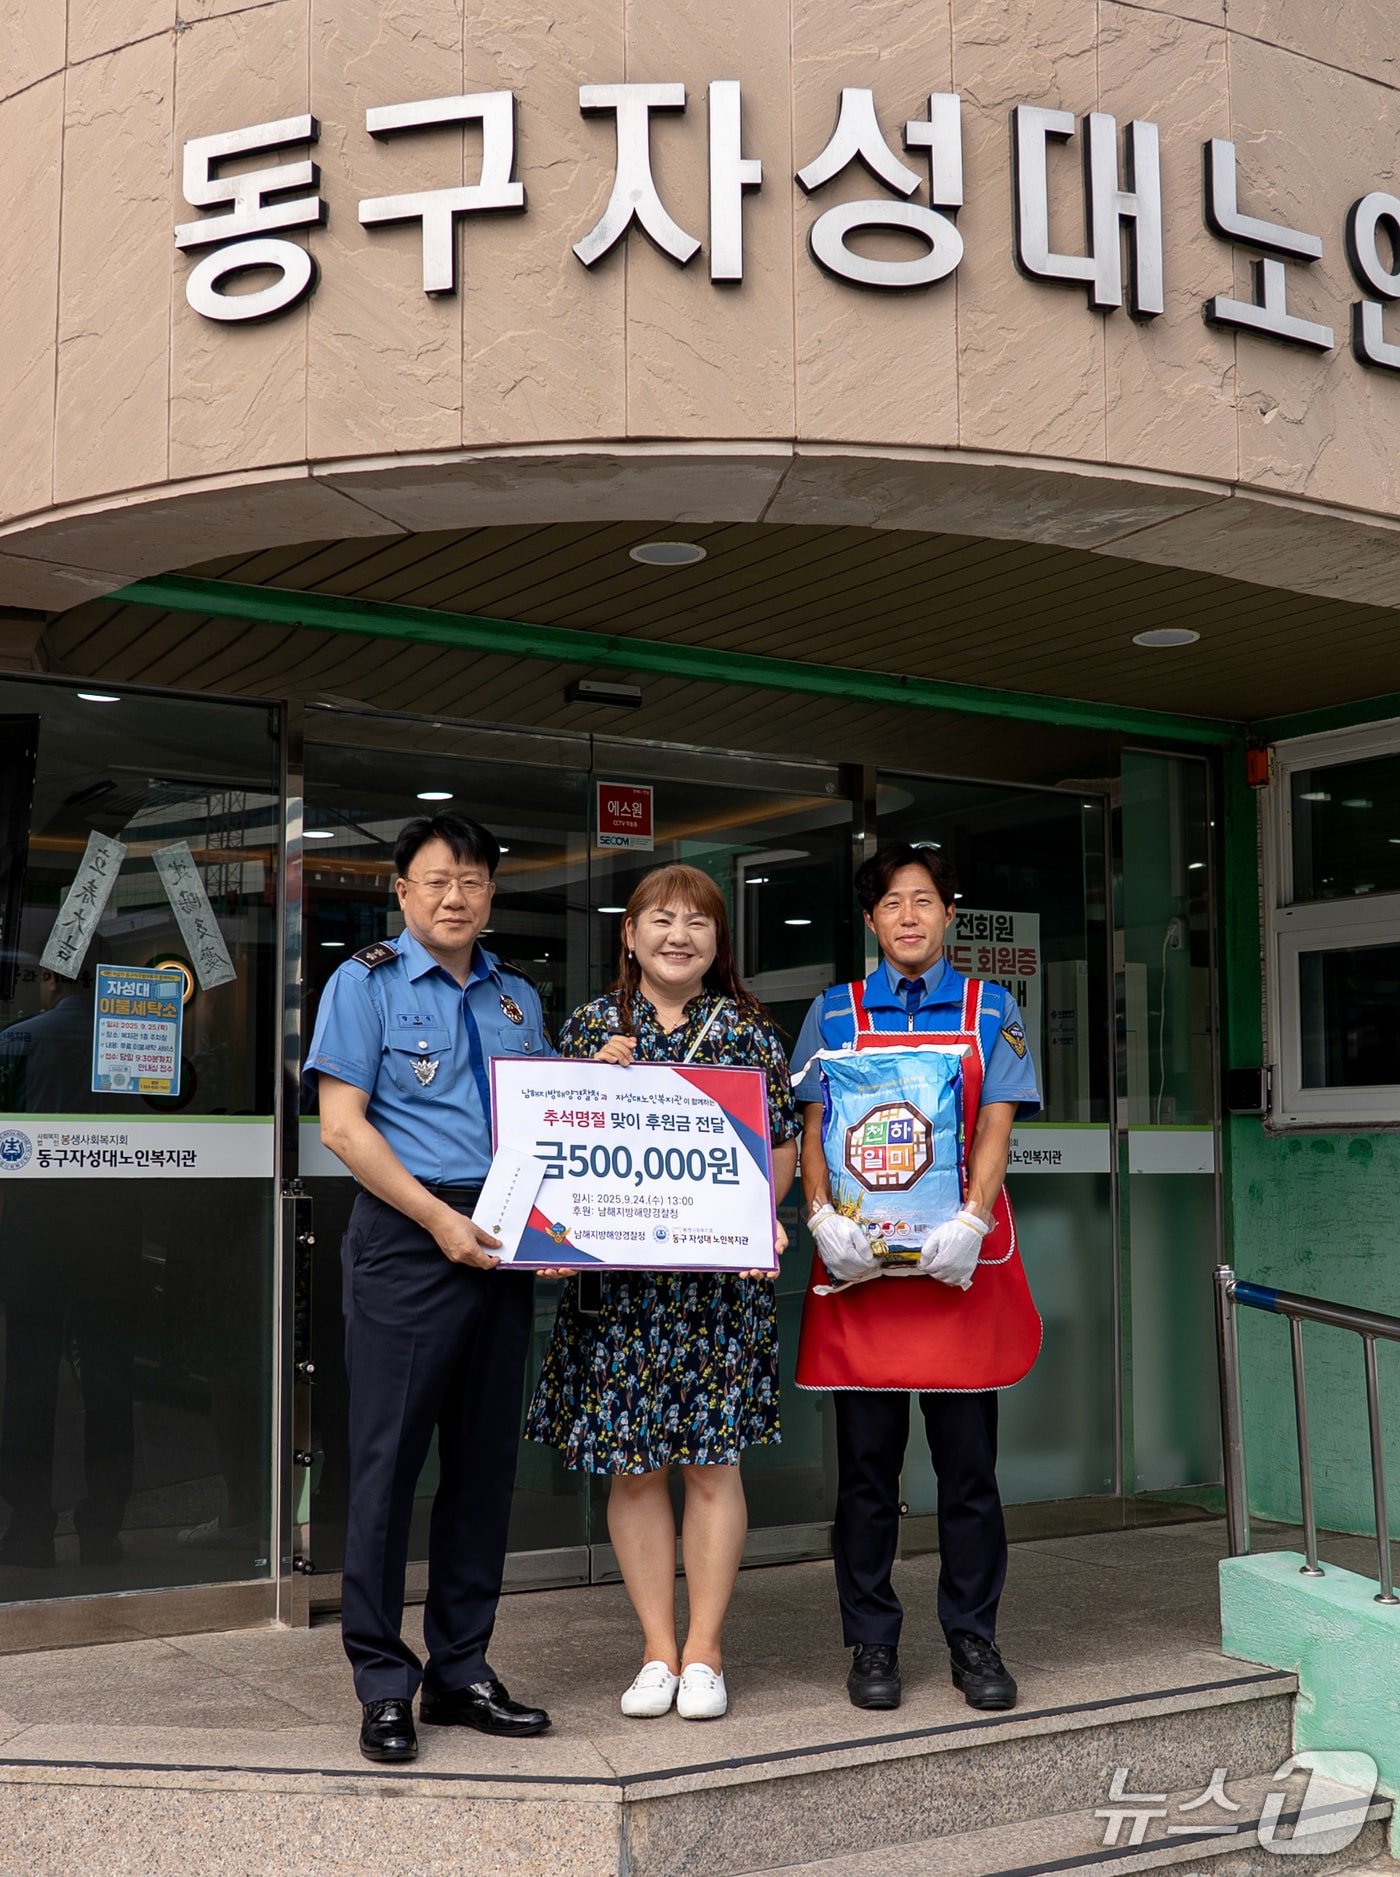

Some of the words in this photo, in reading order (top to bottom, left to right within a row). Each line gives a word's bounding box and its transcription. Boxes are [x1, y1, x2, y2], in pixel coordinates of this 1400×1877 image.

[607, 800, 643, 818] 에스원
[600, 835, 629, 846] SECOM
[977, 946, 1037, 976] 회원증
[107, 980, 150, 998] 자성대
[99, 998, 177, 1019] 이불세탁소
[691, 1097, 716, 1107] 함께하는
[543, 1109, 606, 1128] 추석명절
[610, 1112, 640, 1130] 맞이
[645, 1113, 691, 1132] 후원금
[695, 1116, 725, 1134] 전달
[60, 1133, 128, 1146] 봉생사회복지회
[36, 1149, 198, 1169] 동구자성대노인복지관
[532, 1140, 740, 1187] 금500,000원
[572, 1193, 594, 1204] 일시:
[597, 1193, 664, 1207] 2025.9.24.(수)
[667, 1196, 694, 1206] 13:00
[572, 1206, 594, 1217] 후원:
[597, 1207, 679, 1219] 남해지방해양경찰청
[574, 1229, 646, 1241] 남해지방해양경찰청
[672, 1233, 687, 1244] 동구
[689, 1234, 711, 1245] 자성대
[713, 1235, 749, 1246] 노인복지관
